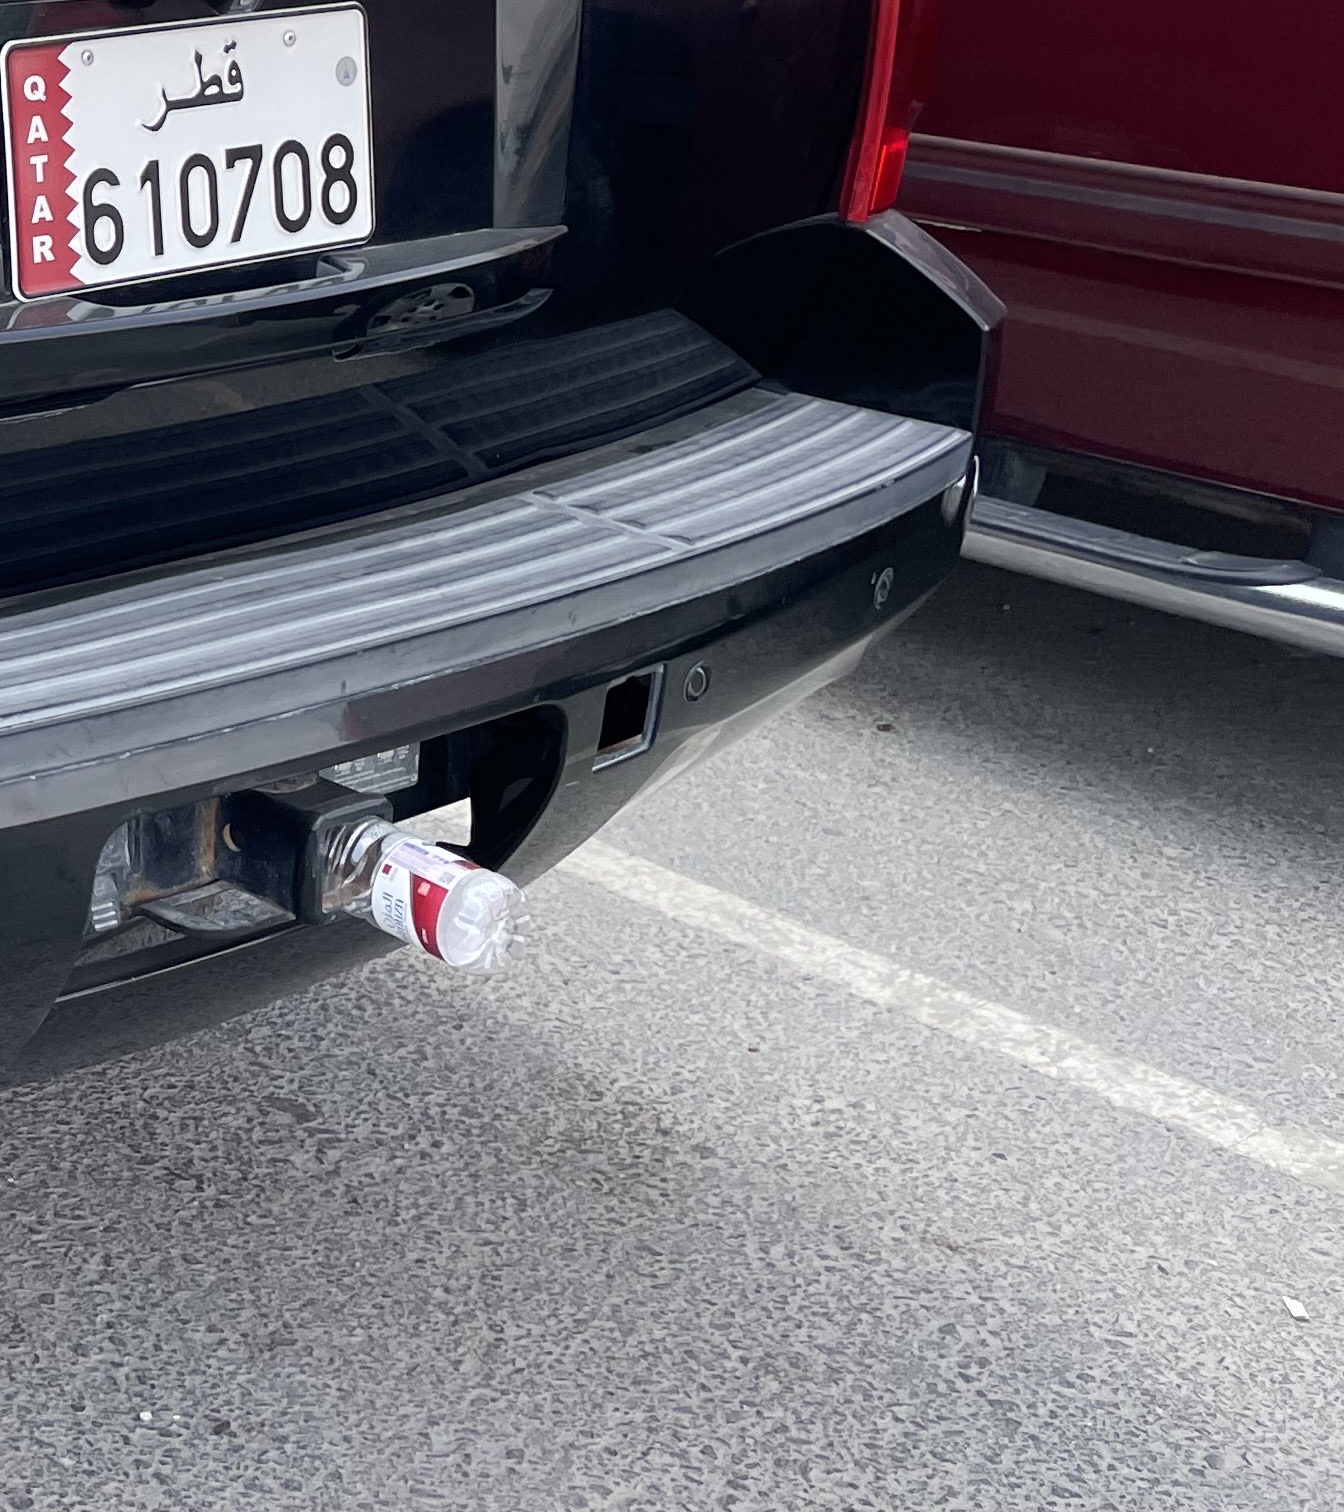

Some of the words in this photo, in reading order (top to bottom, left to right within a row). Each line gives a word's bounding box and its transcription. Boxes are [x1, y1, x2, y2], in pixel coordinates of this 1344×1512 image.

[141, 39, 245, 132] قطر
[23, 75, 56, 264] QATAR
[82, 133, 358, 266] 610708
